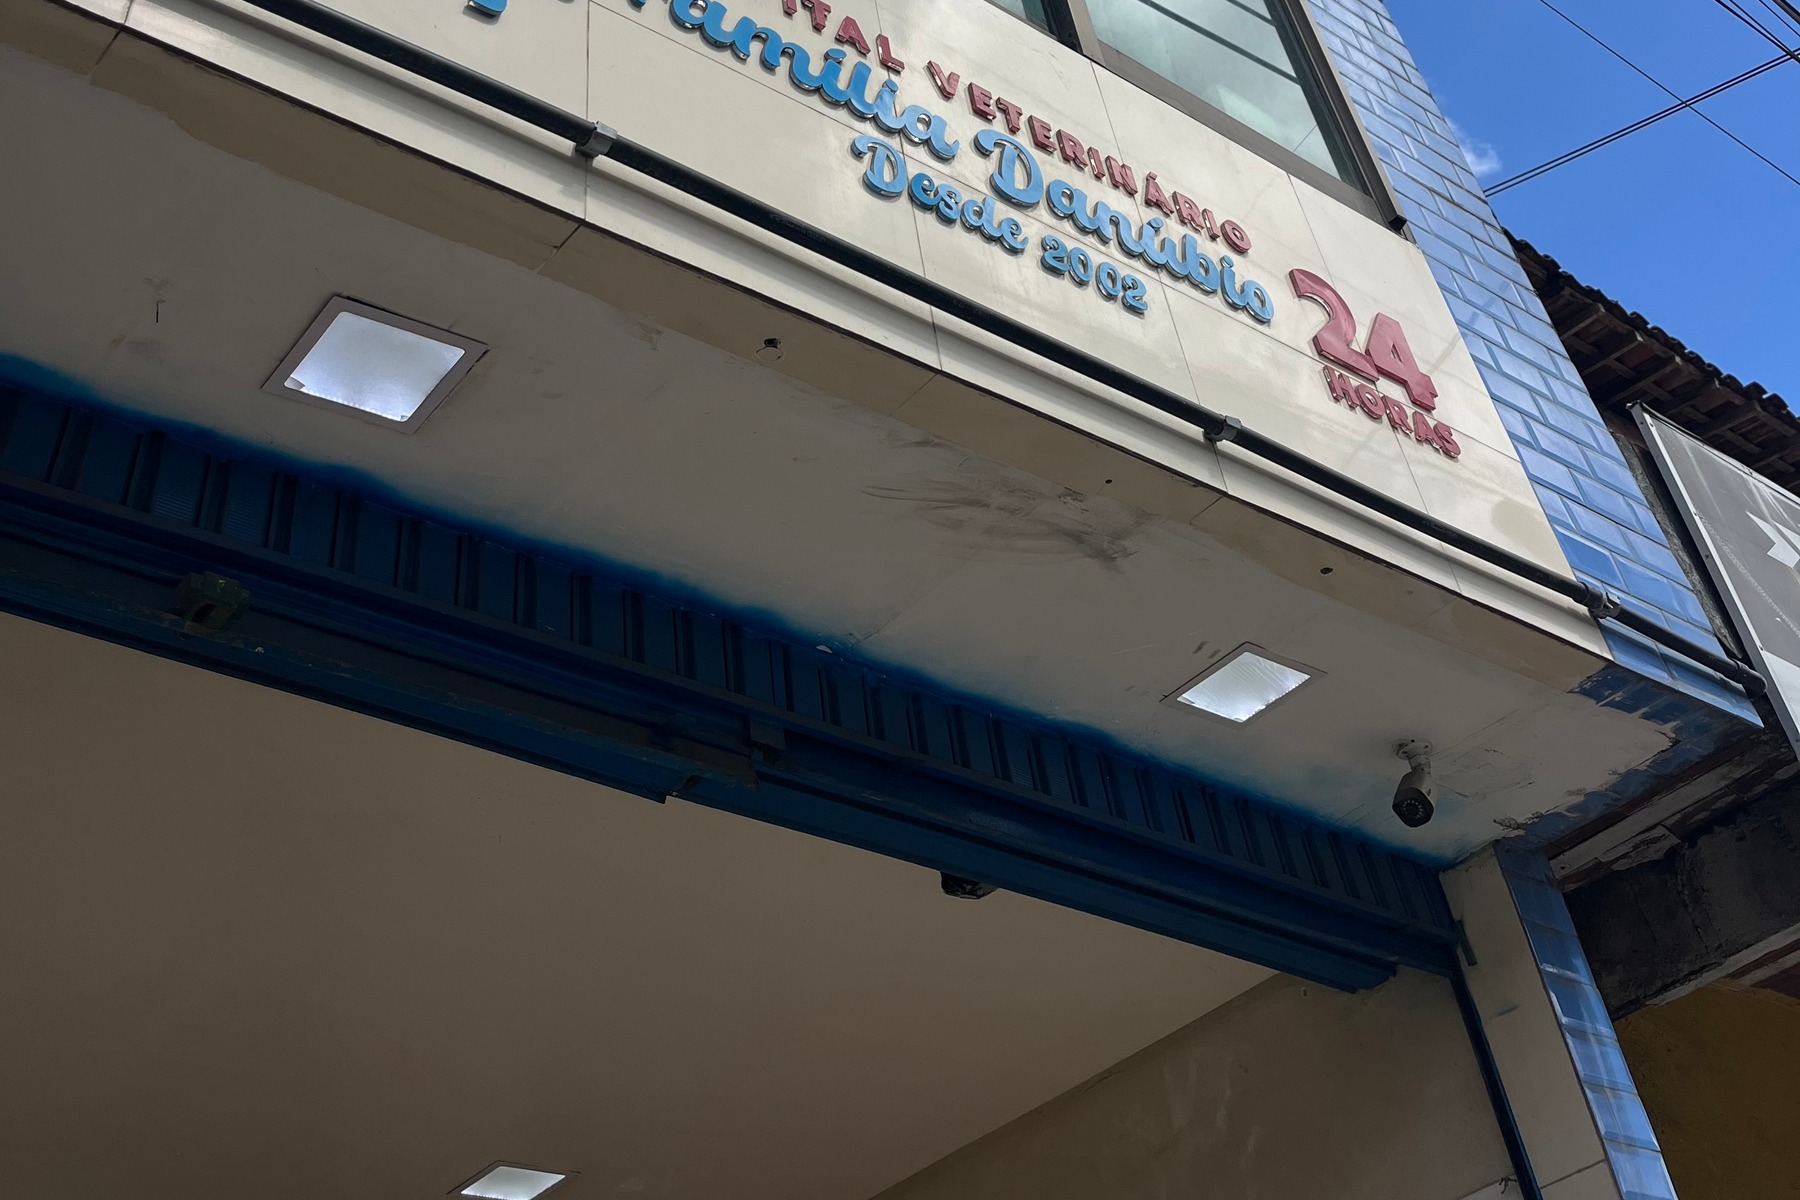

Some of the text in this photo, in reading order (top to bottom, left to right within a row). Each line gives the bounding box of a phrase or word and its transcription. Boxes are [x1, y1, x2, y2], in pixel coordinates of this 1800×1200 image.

[850, 134, 1149, 315] Desde 2002
[1288, 268, 1439, 412] 24
[1322, 365, 1462, 459] HORAS
